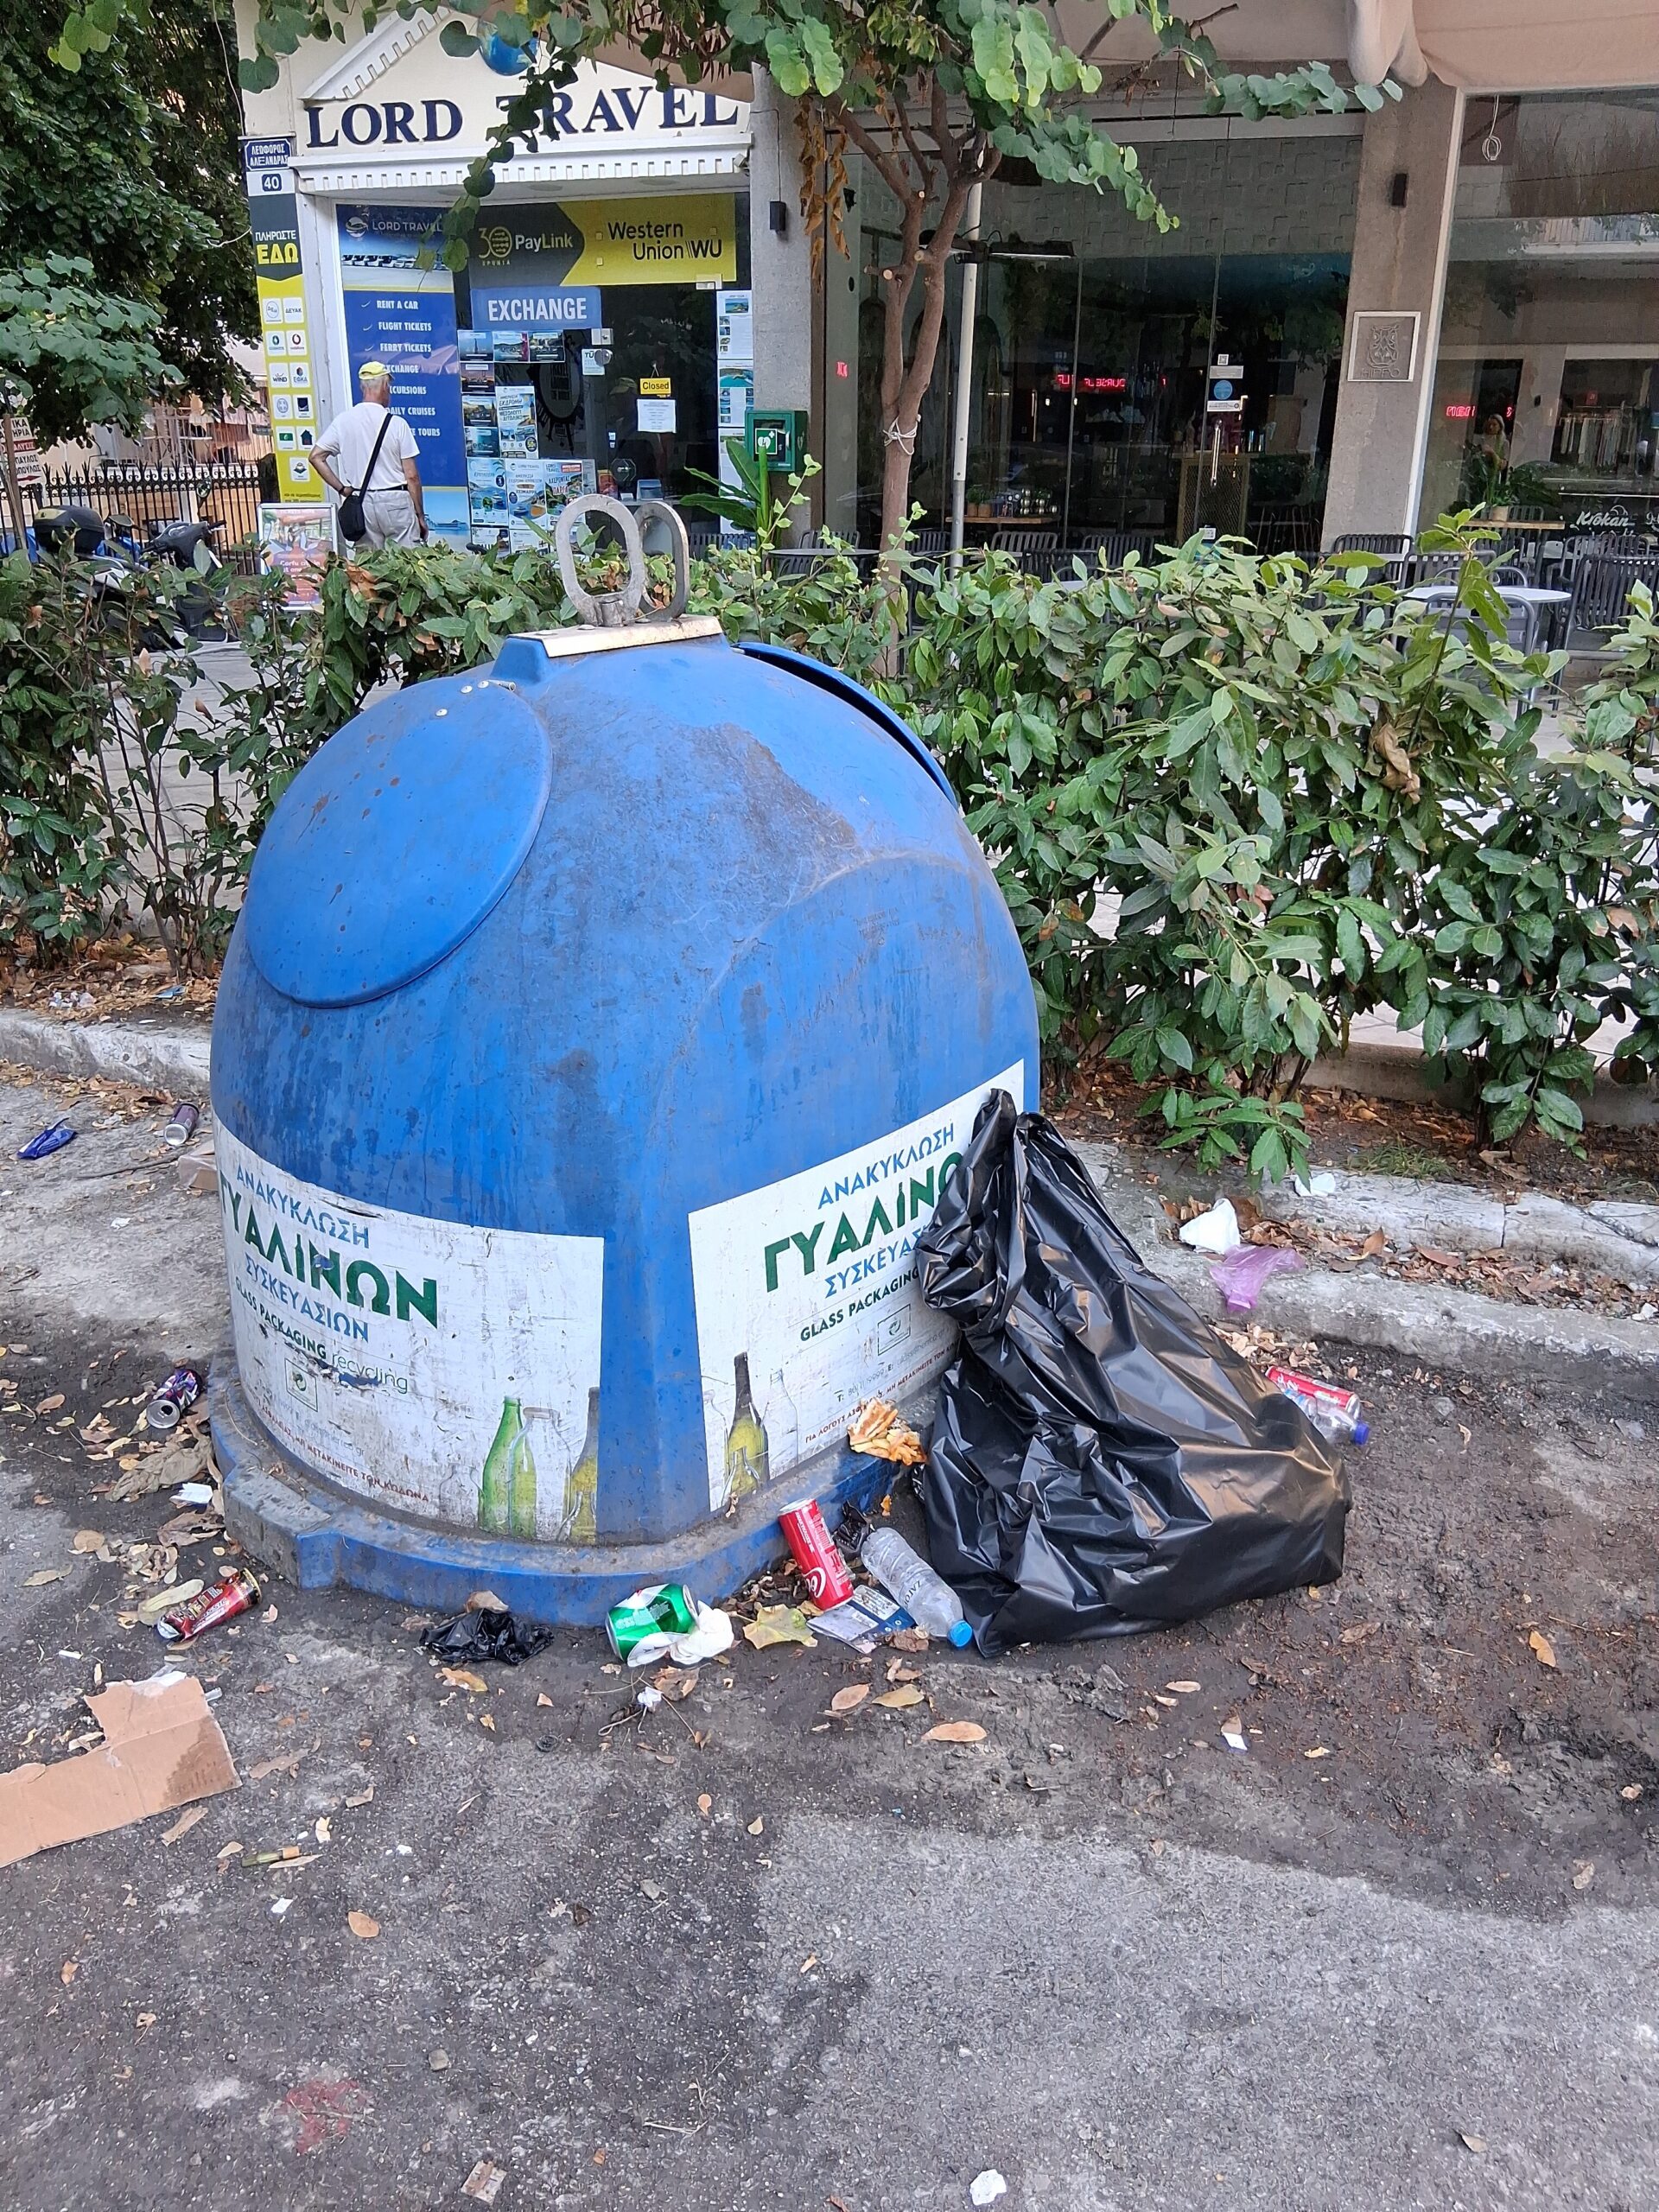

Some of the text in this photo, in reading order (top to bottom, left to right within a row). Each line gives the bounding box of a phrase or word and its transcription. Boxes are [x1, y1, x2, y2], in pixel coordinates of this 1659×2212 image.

[303, 99, 463, 149] LORD
[251, 143, 285, 156] ΛΕΩΦΟΡΟΣ
[250, 155, 288, 166] ΑΛΕΞΑΝΔΡΑΣ
[264, 176, 279, 189] 40
[372, 219, 402, 231] LORD
[607, 220, 683, 241] Western
[255, 230, 296, 241] ΠΛΗΡΩΣΤΕ
[515, 233, 574, 253] PayLink
[257, 243, 299, 264] ΕΔΩ
[632, 241, 684, 261] Union
[377, 300, 419, 309] RENT A CAR
[487, 297, 588, 322] EXCHANGE
[378, 321, 432, 332] FLIGHT TICKETS
[380, 343, 432, 353] FERRY TICKETS
[1361, 368, 1400, 378] HIPPO
[389, 385, 427, 395] XCURSIONS
[642, 382, 670, 391] Closed
[407, 406, 435, 416] CRUISES
[418, 428, 441, 437] TOURS
[1575, 511, 1629, 526] Krokan
[817, 1122, 954, 1210] ΑΝΑΚΥΚΛΩΣΗ
[236, 1163, 370, 1249] ΑΝΑΚΥΚΛΩΣΗ
[764, 1151, 963, 1294] ΓΥΑΛΙΝΩ
[219, 1169, 438, 1330] ΓΥΑΛΙΝΩΝ
[245, 1252, 370, 1344] ΣΥΣΚΕΥΑΣΙΩΝ
[800, 1266, 919, 1342] GLASS PACKAGING
[235, 1276, 408, 1395] GLASS PACKAGING recycling
[805, 1433, 817, 1443] ΓΙΑ
[818, 1416, 846, 1437] ΛΟΓΟΥΣ
[887, 1383, 896, 1394] ΜΗ
[308, 1444, 359, 1478] ΜΕΤΑΚΙΝΕΙΤΕ
[384, 1481, 429, 1503] ΚΩΔΩΝΑ
